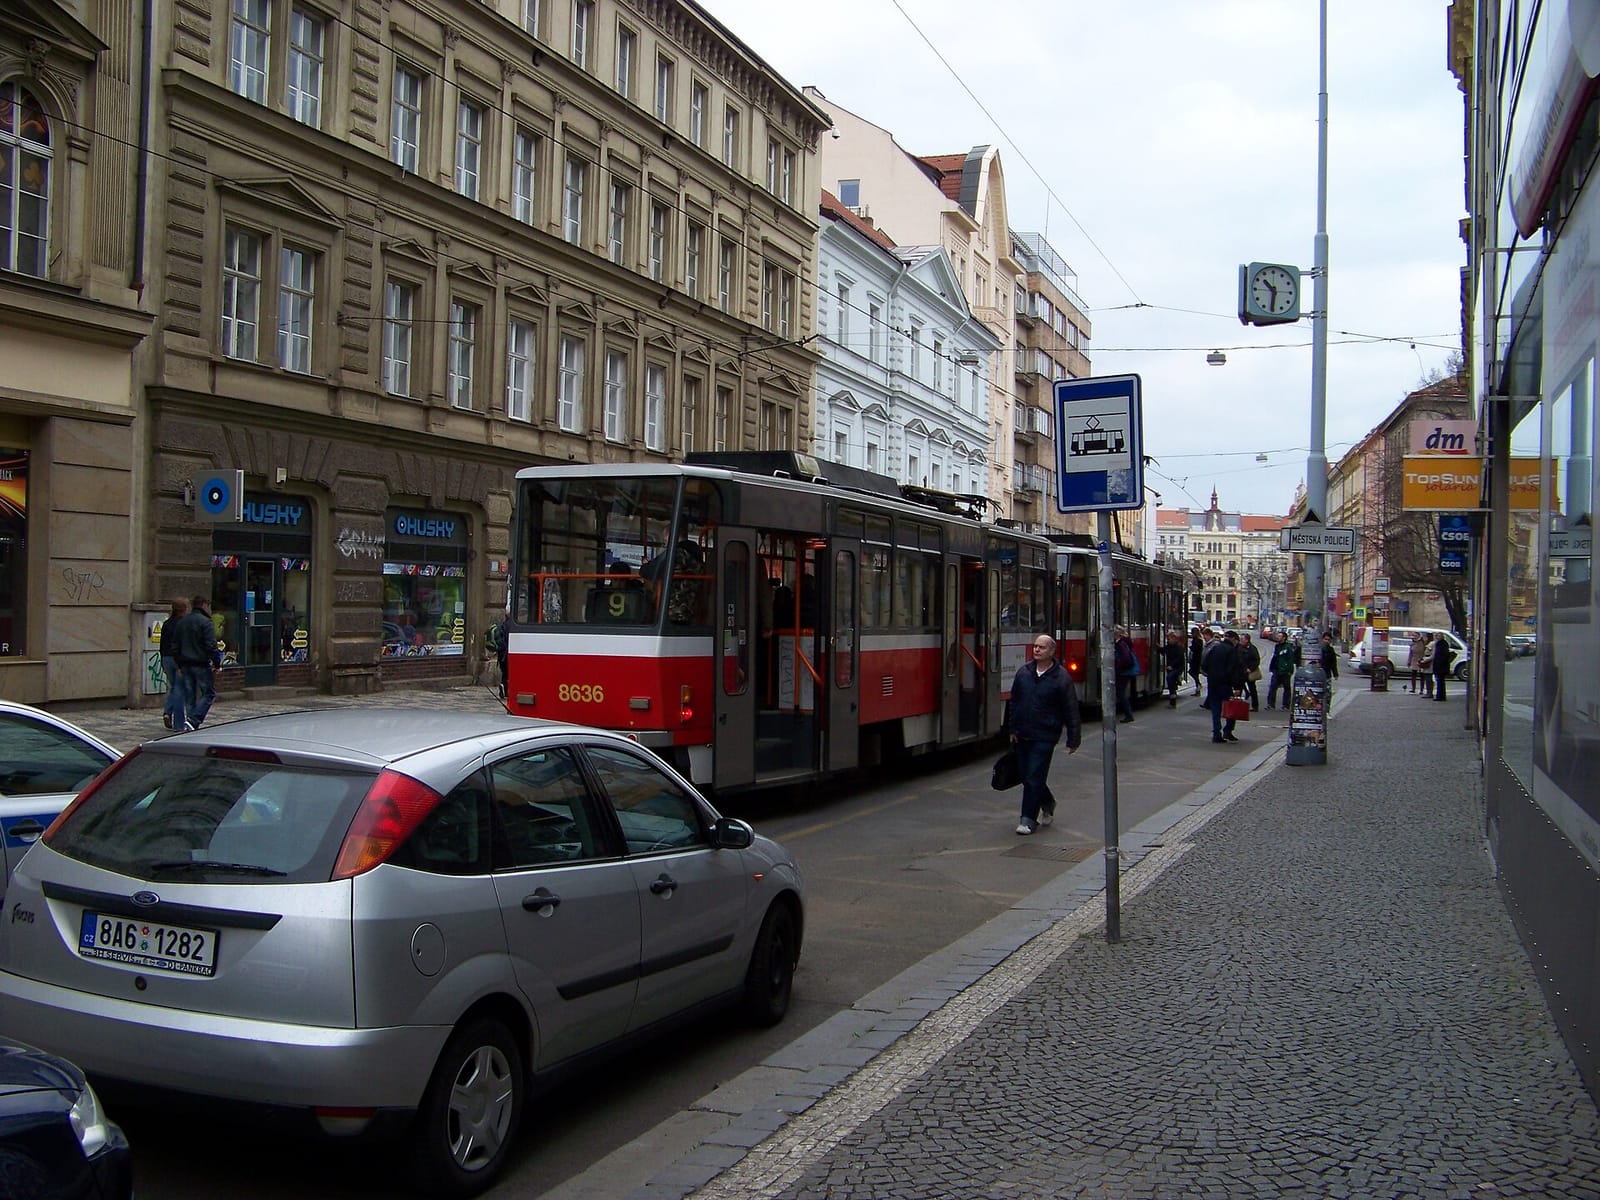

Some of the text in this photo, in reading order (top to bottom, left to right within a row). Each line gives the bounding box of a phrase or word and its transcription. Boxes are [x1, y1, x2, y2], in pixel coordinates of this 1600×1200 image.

[1425, 427, 1465, 449] dm
[1324, 535, 1350, 546] POLICIE
[608, 592, 625, 617] 9
[558, 683, 604, 703] 8636
[84, 934, 95, 943] CZ
[100, 919, 206, 961] 8A6 1282
